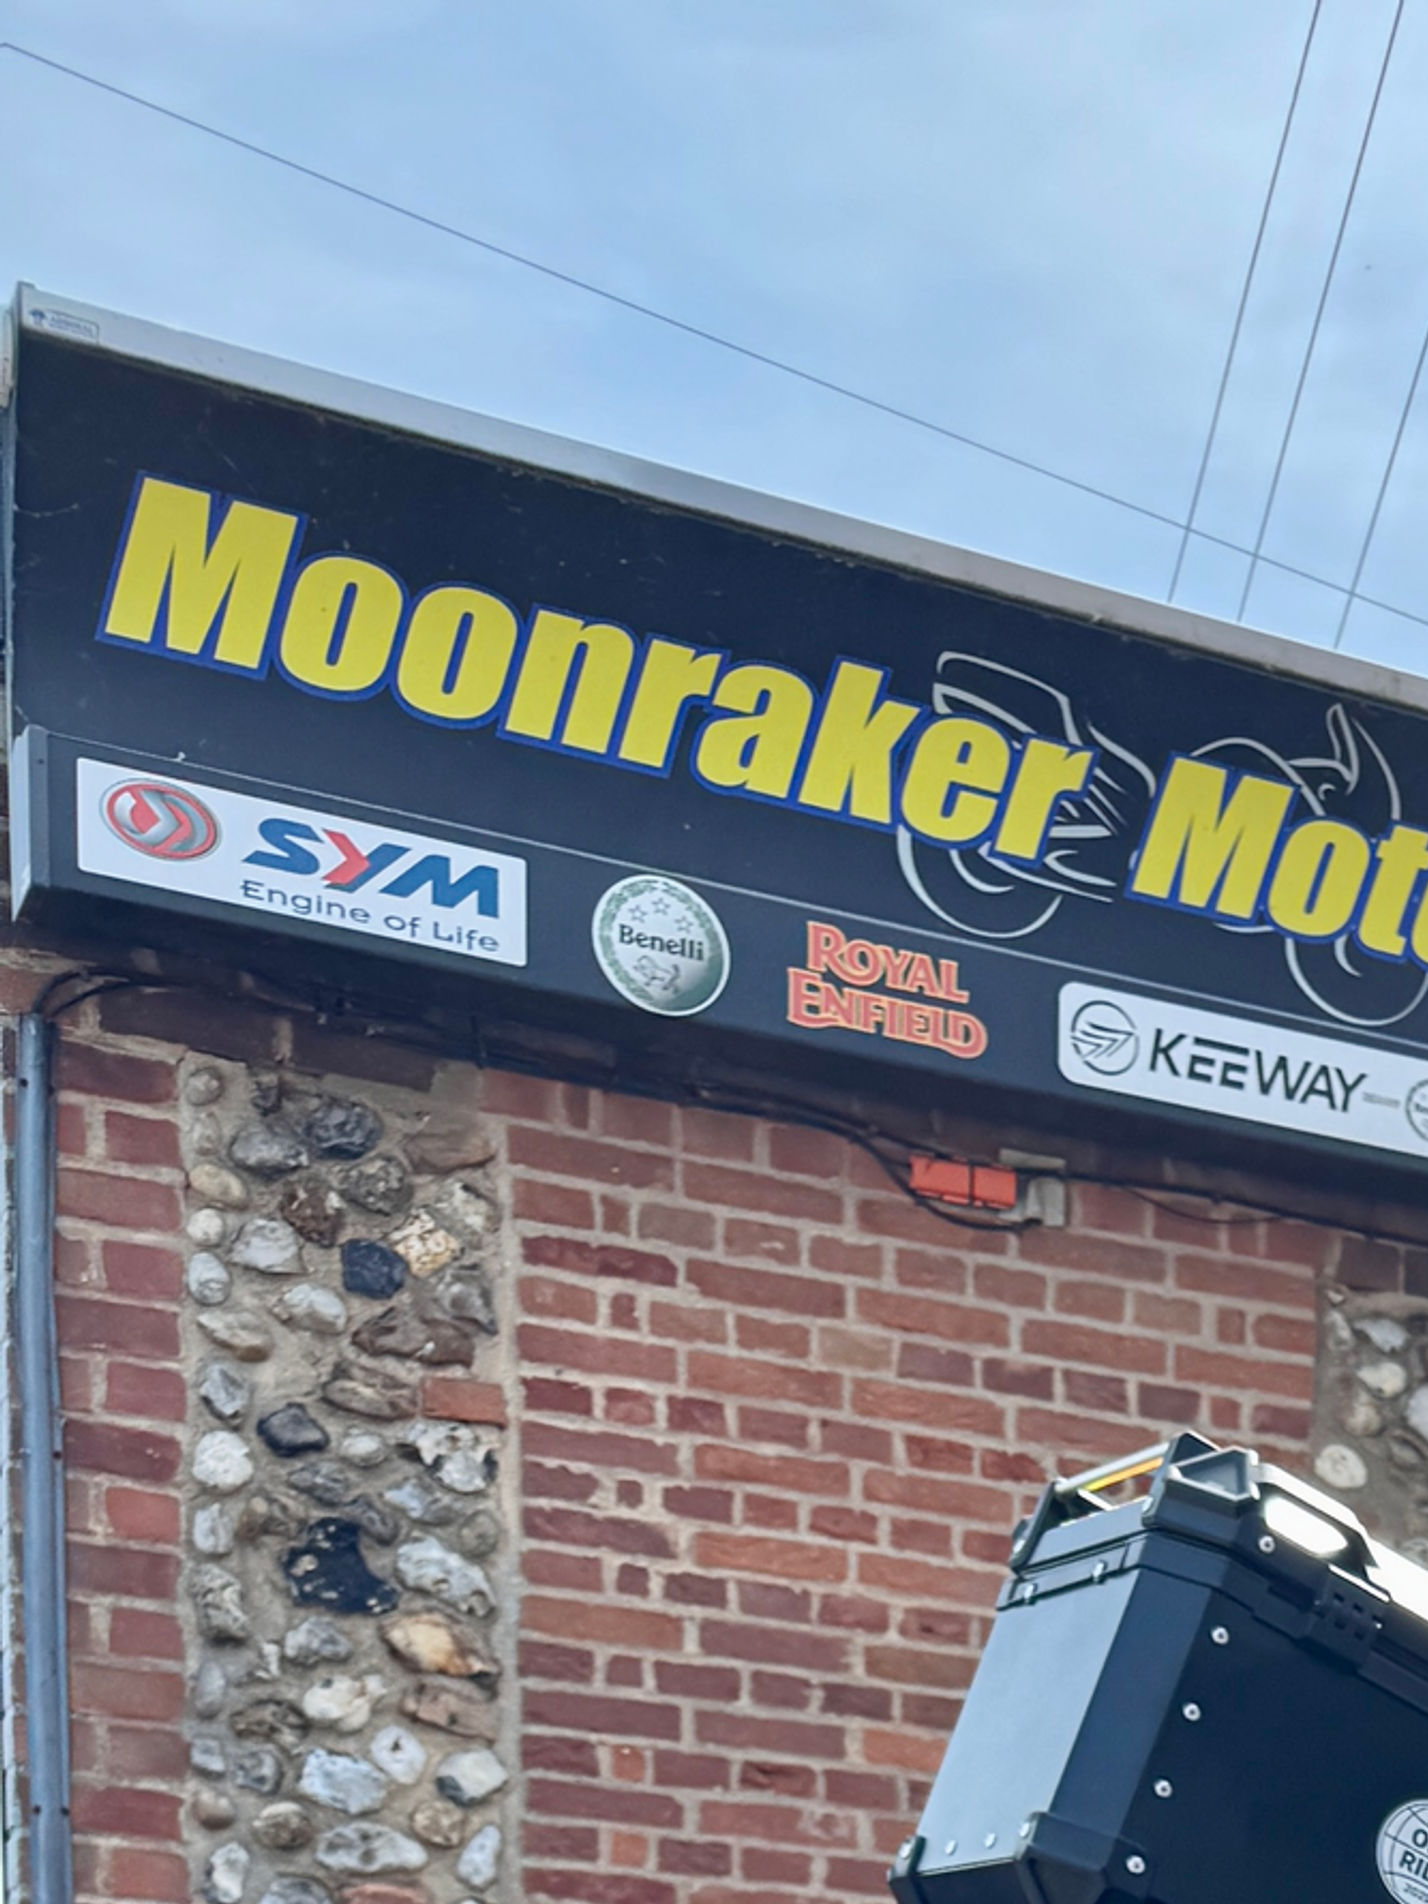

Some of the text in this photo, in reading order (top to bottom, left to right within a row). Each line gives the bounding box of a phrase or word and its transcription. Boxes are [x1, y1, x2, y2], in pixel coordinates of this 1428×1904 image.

[95, 472, 1098, 867] Moonraker
[243, 818, 498, 918] SYM
[240, 880, 500, 952] Engine of Life
[619, 923, 704, 961] Benelli
[806, 920, 970, 1003] ROYAL
[786, 967, 988, 1059] ENFIELD
[1148, 1028, 1368, 1113] KEEWAY
